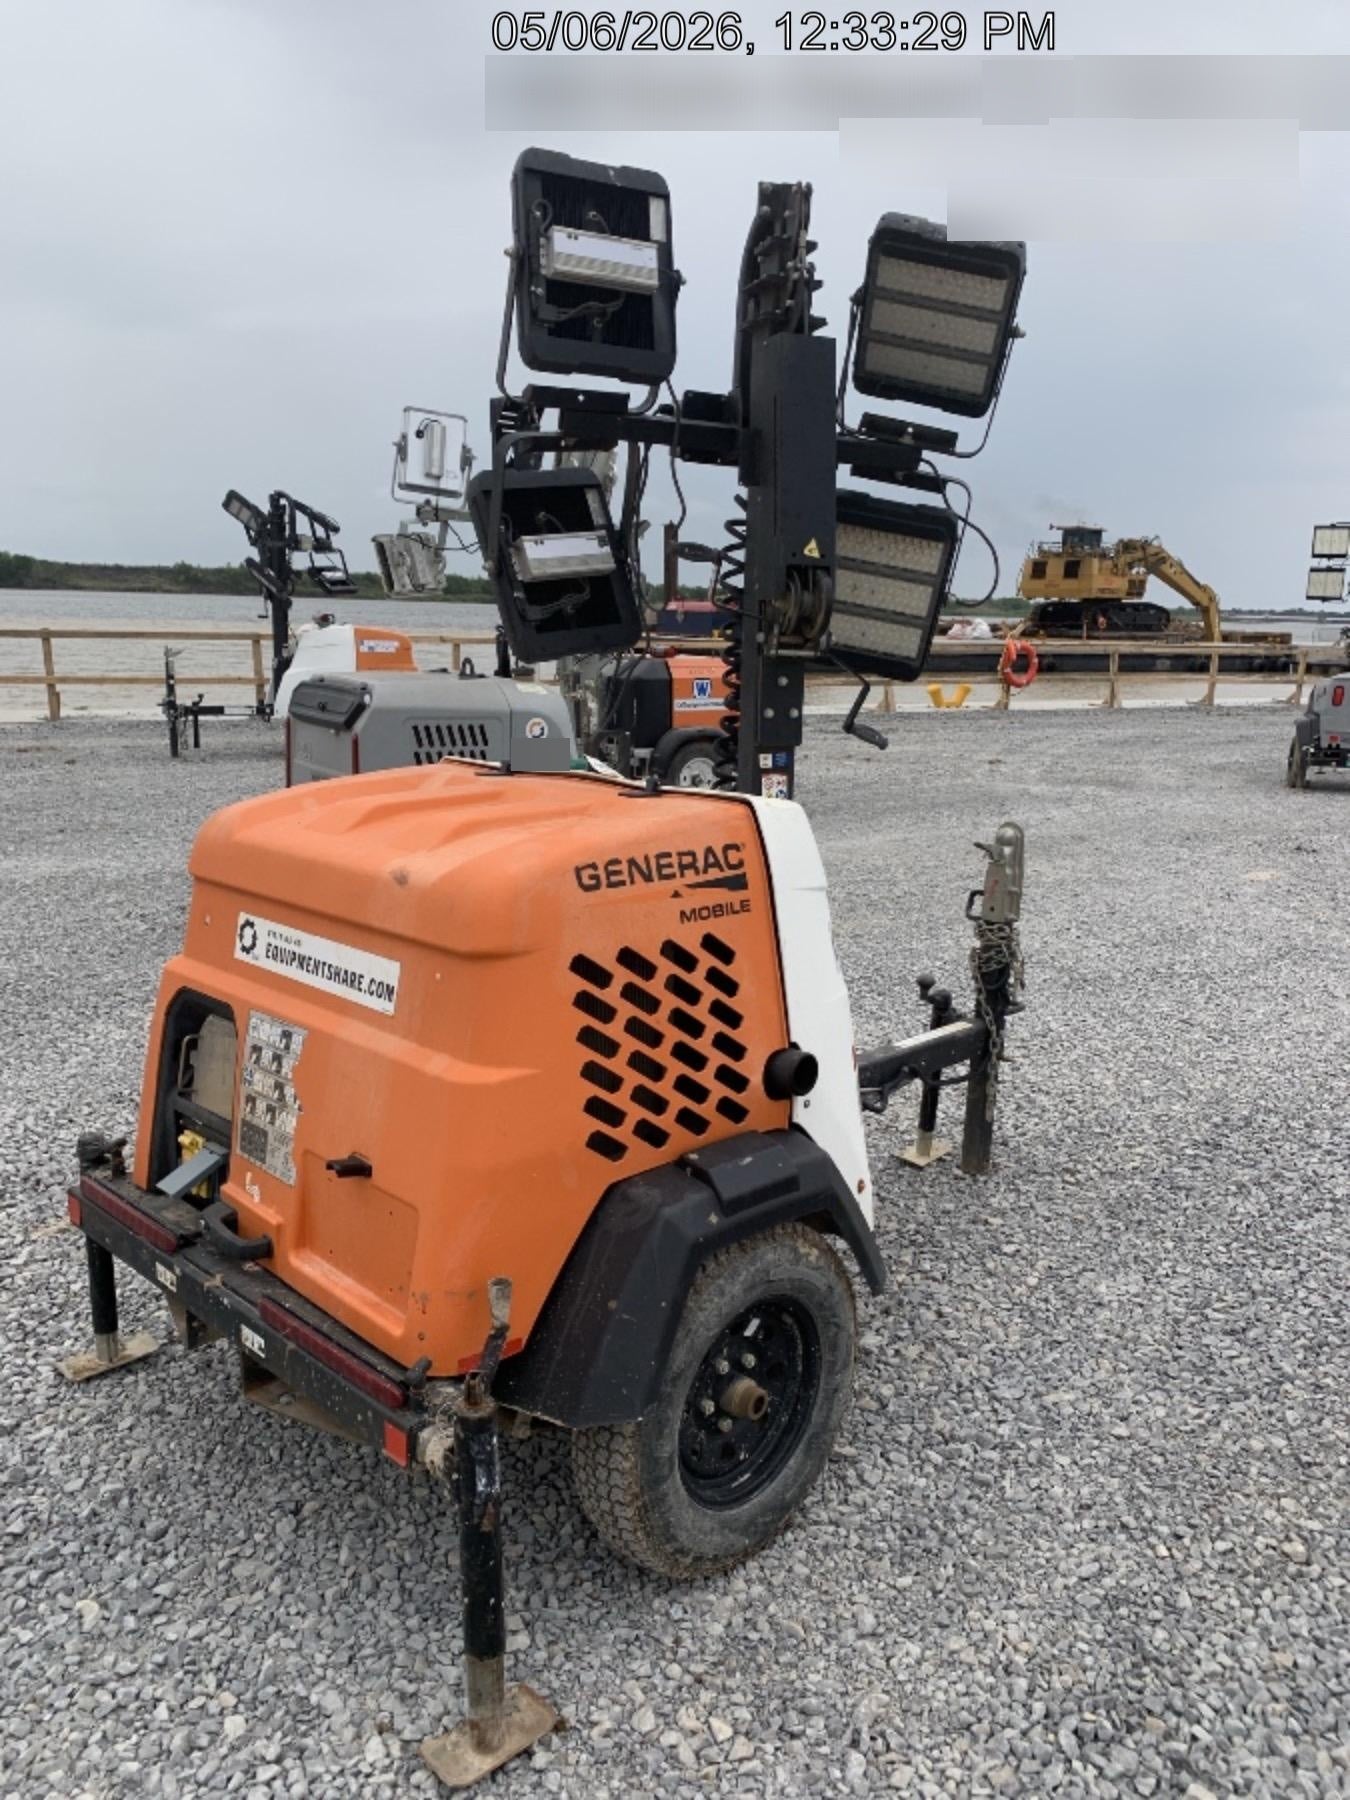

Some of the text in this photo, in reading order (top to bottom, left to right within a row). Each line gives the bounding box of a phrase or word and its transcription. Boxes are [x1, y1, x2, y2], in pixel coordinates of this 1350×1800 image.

[574, 843, 745, 892] GENERAC
[679, 899, 752, 924] MOBILE
[265, 943, 395, 1003] EQUIPMENTSHARE.COM
